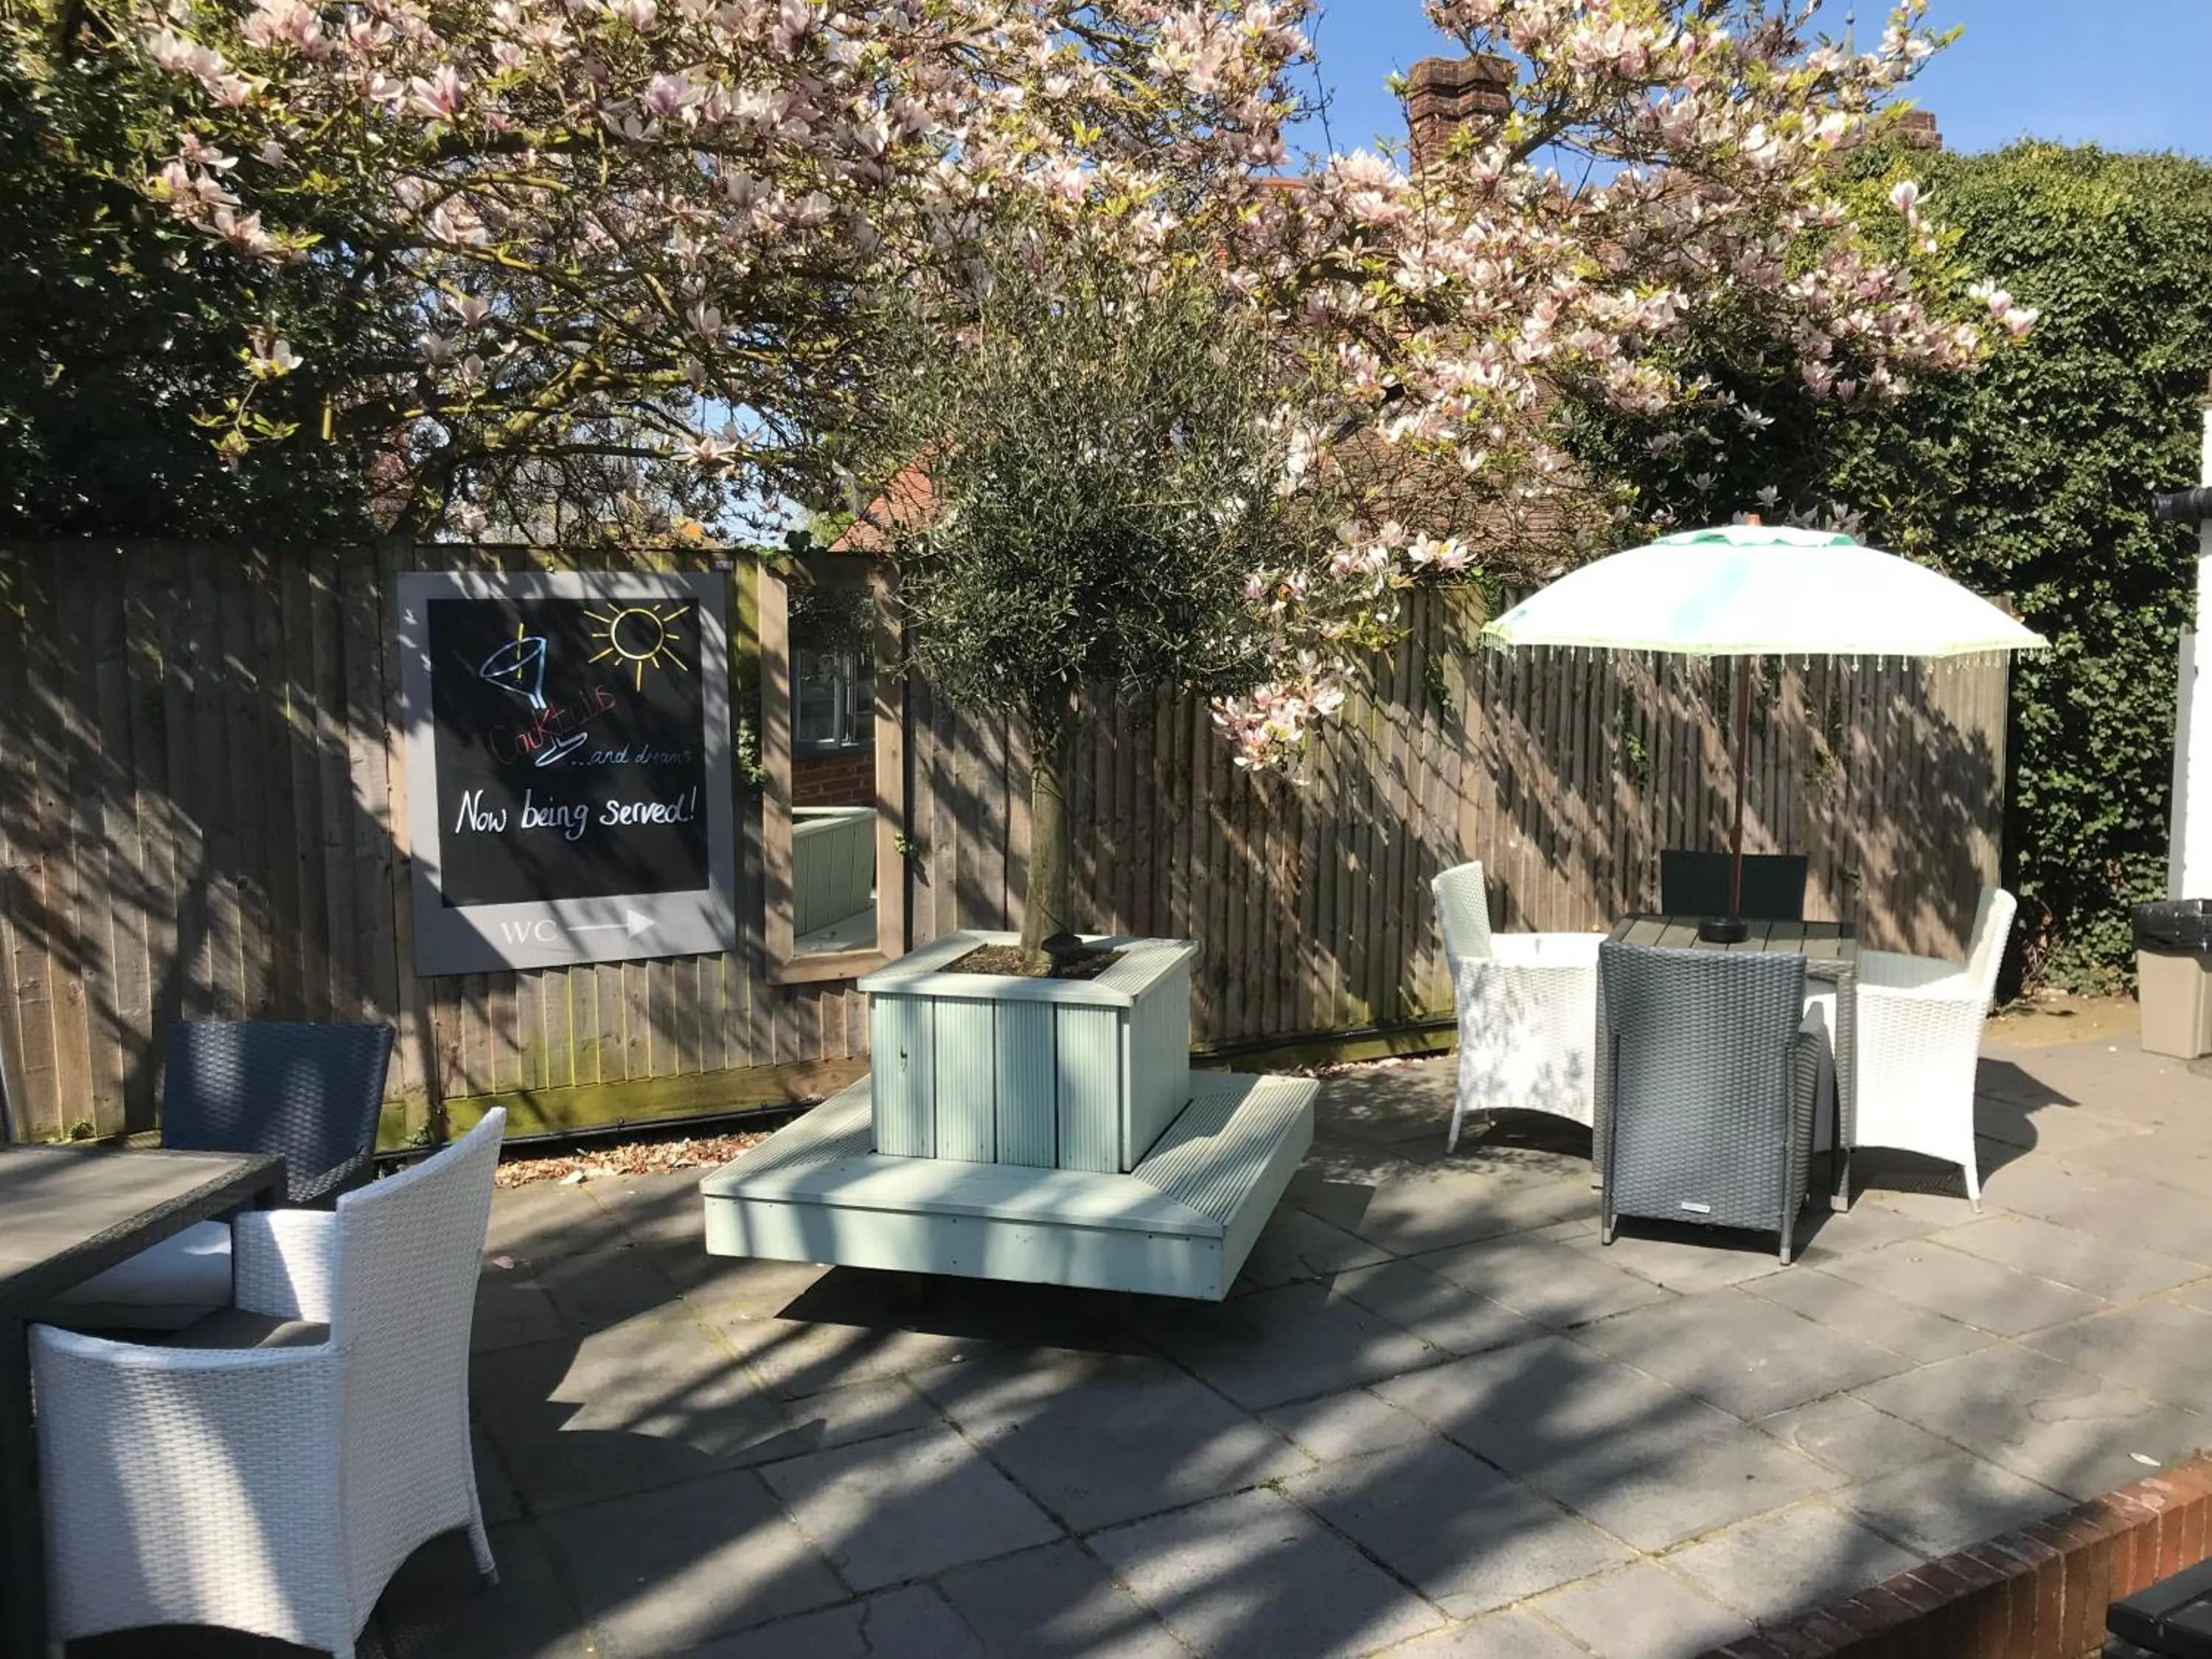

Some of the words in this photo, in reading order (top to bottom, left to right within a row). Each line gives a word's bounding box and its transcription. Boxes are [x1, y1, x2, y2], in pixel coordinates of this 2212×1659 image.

[455, 789, 507, 834] Now
[521, 788, 589, 841] being
[501, 919, 559, 945] WC
